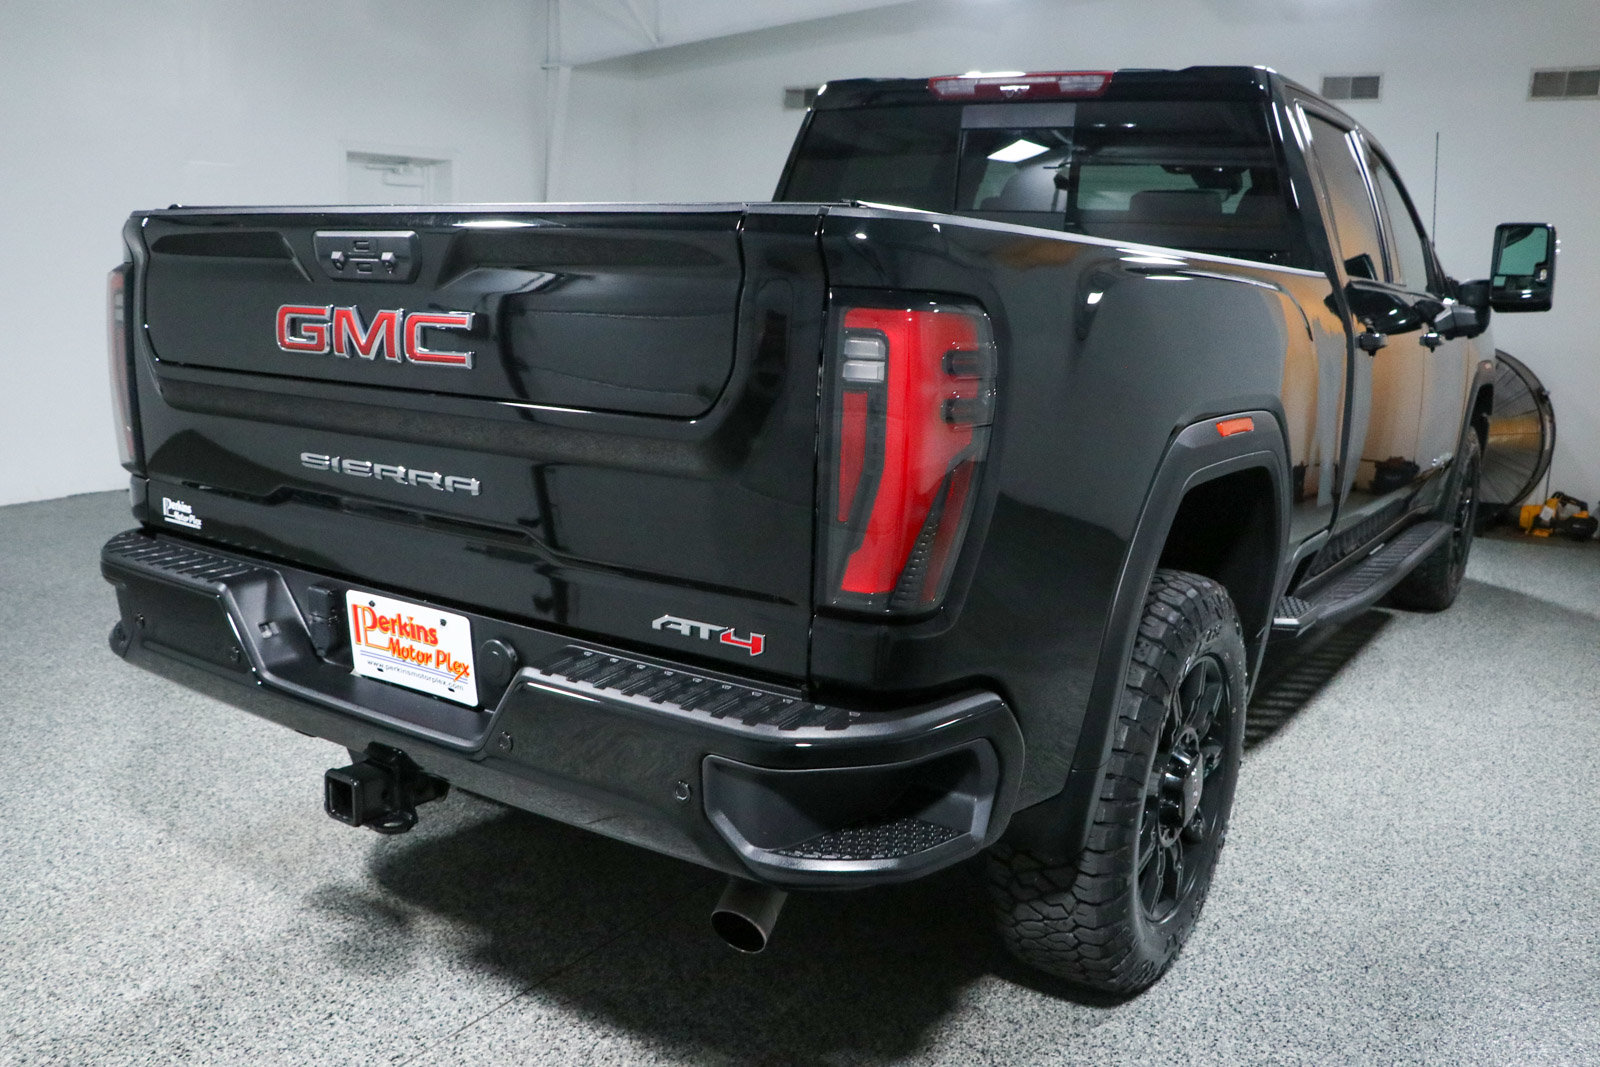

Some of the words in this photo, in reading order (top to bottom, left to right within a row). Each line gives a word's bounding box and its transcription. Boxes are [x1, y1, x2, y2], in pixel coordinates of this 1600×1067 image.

[276, 304, 475, 369] GMC
[300, 452, 481, 496] SIERRA
[352, 604, 439, 646] Perkins
[652, 614, 765, 656] AT4
[388, 637, 432, 666] Motor
[435, 649, 470, 682] Plex
